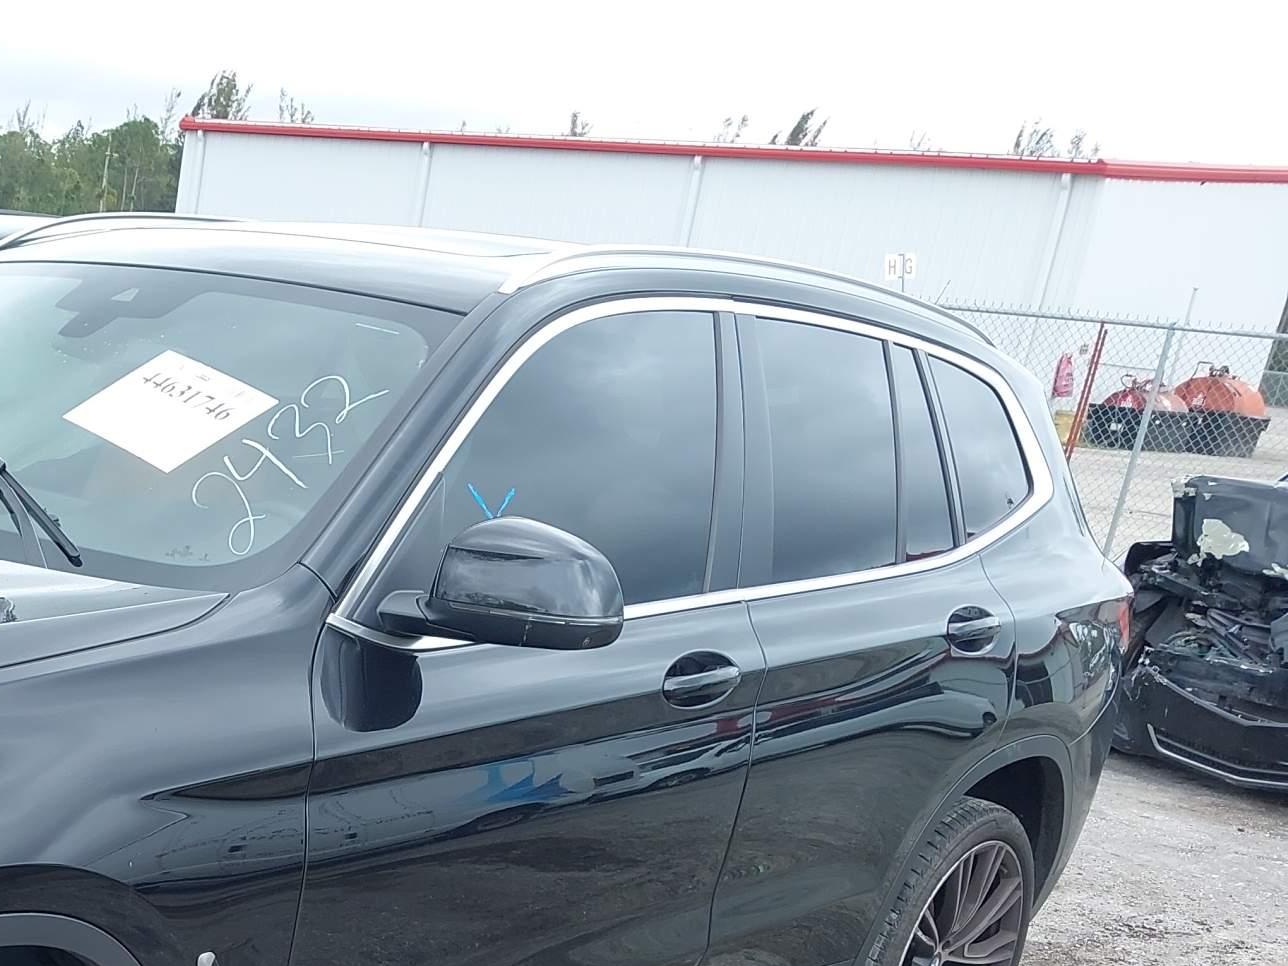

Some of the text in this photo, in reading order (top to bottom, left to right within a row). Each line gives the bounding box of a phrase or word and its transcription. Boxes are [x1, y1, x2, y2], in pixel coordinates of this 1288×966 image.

[888, 259, 896, 276] H
[905, 257, 913, 275] G
[142, 372, 235, 421] 44631746
[191, 374, 390, 555] 2432
